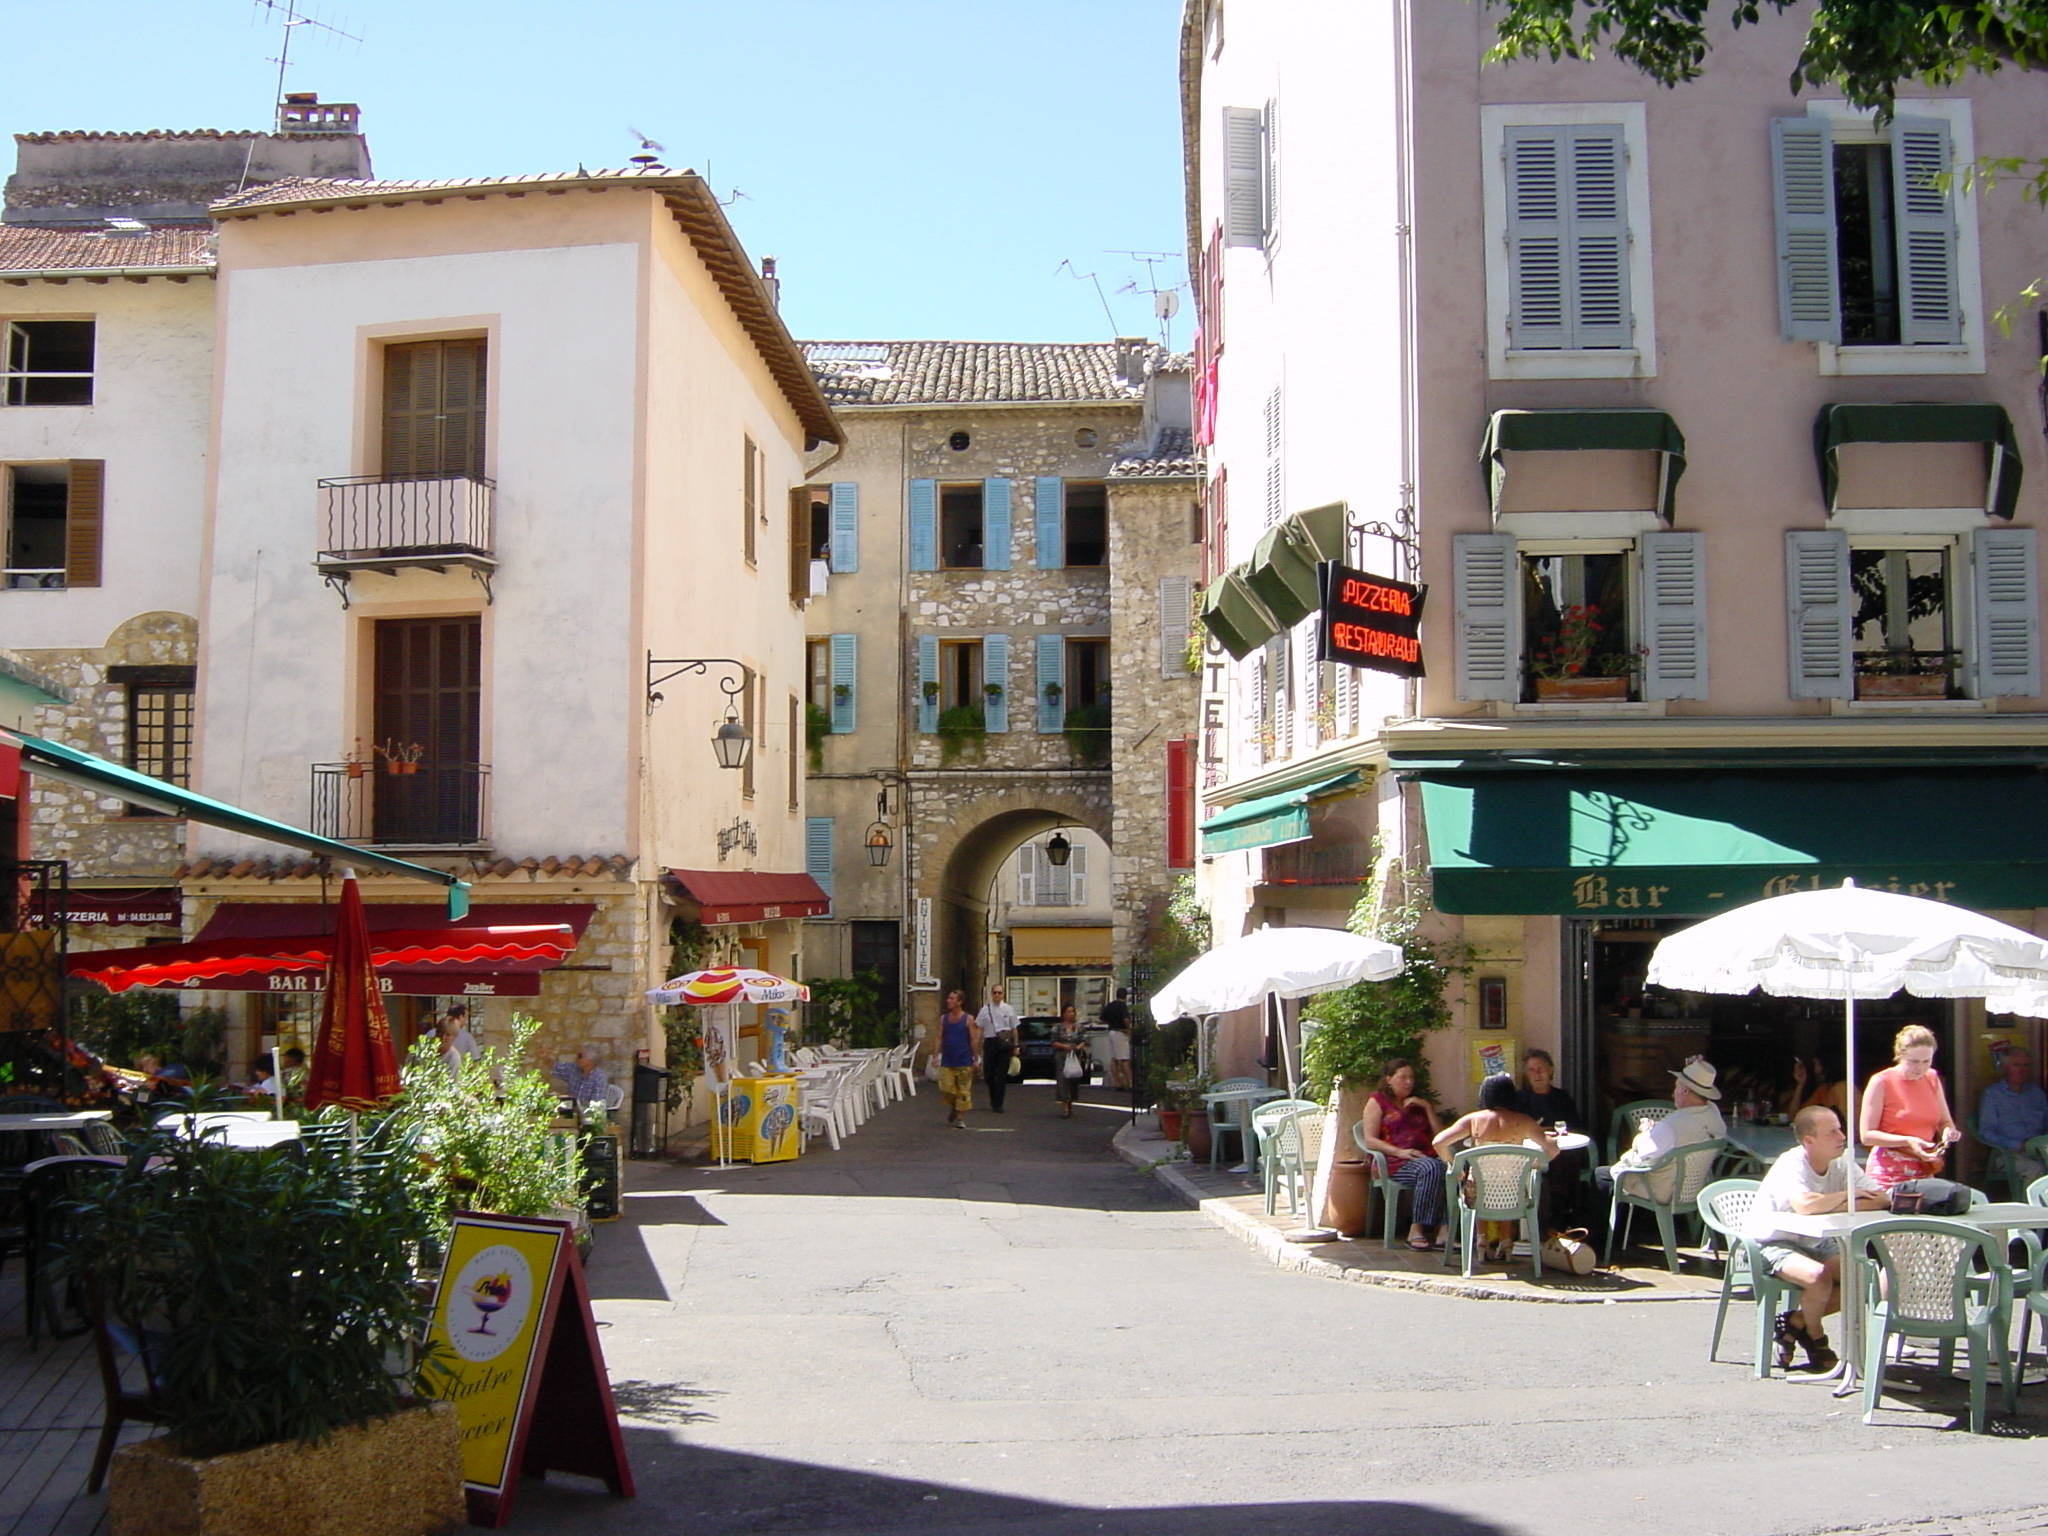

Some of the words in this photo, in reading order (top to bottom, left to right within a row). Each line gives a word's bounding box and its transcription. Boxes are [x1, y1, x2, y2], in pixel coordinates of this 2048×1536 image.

[1343, 579, 1411, 616] PIZZERIA
[1205, 630, 1226, 763] OTEL
[1572, 874, 1670, 908] Bar
[1763, 873, 1957, 902] Glier
[268, 975, 308, 990] BAR
[762, 989, 786, 1001] Miko
